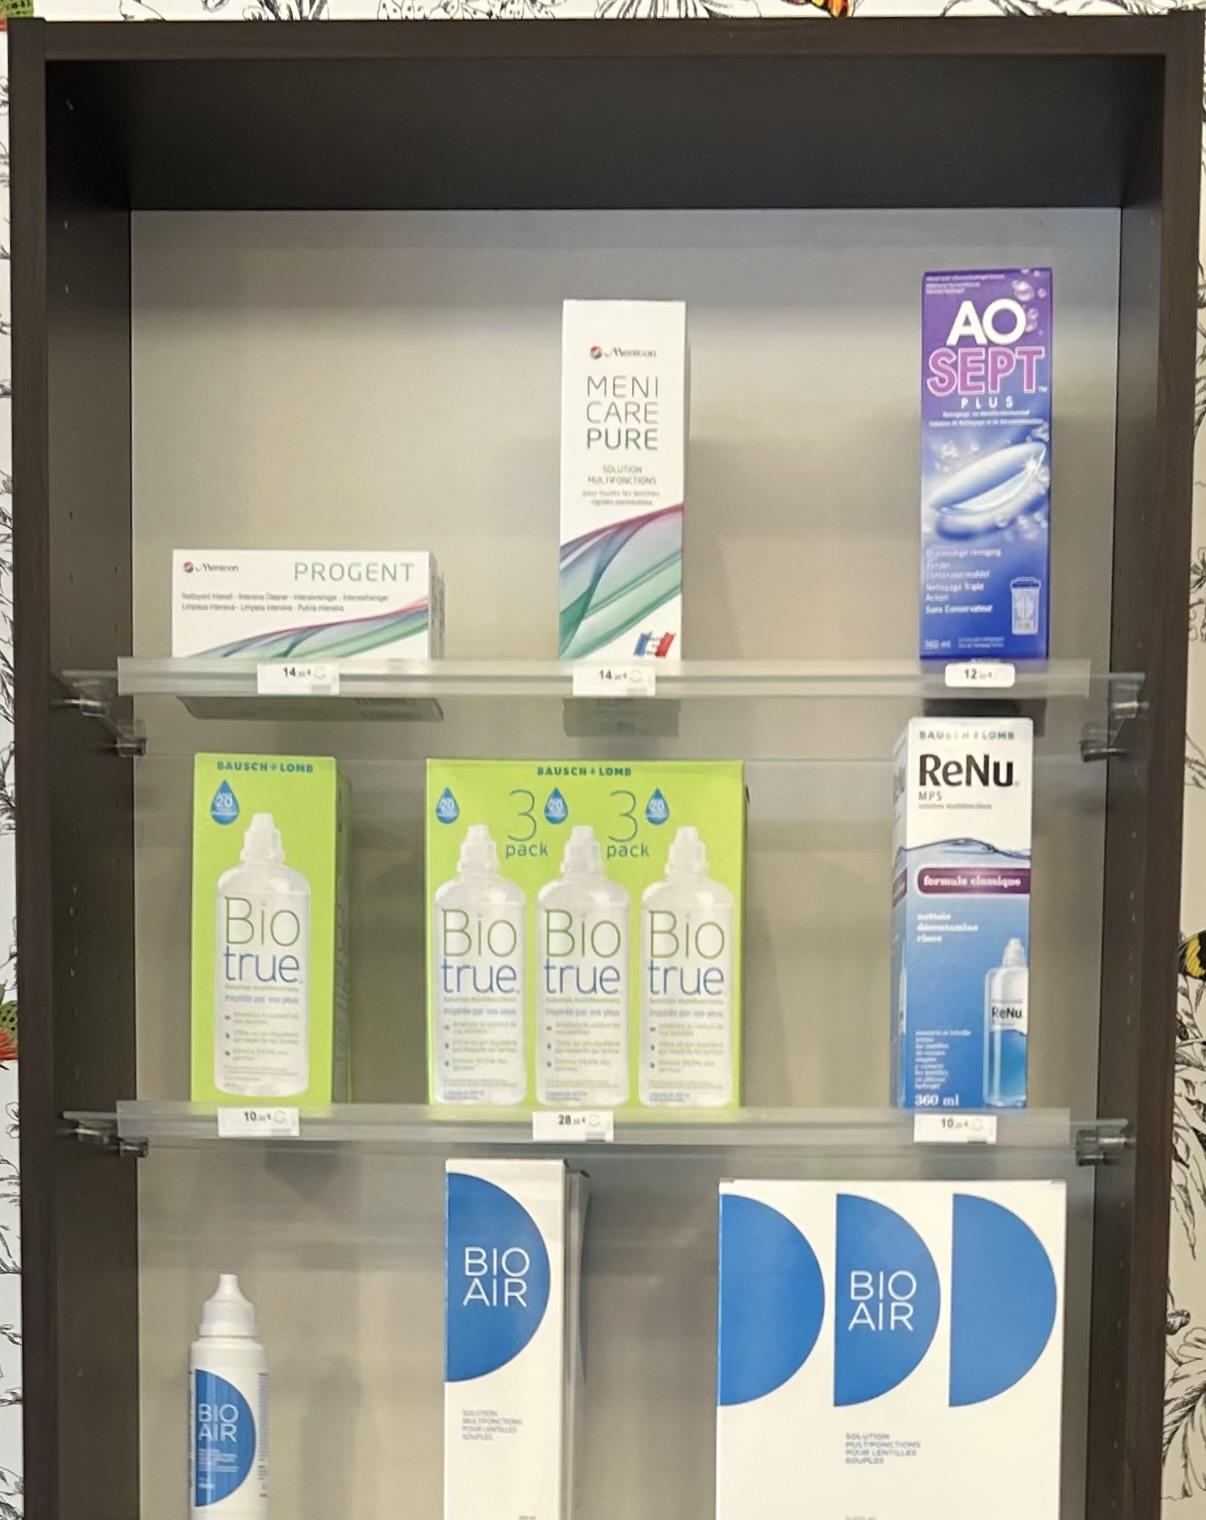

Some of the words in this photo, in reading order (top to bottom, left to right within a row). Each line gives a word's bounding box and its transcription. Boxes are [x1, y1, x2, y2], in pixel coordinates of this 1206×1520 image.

[946, 298, 1026, 345] AO
[604, 347, 656, 358] Menicon
[927, 346, 1045, 397] SEPT
[587, 376, 658, 398] MENI
[586, 401, 658, 424] CARE
[961, 396, 1013, 409] PLUS
[587, 428, 658, 450] PURE
[603, 464, 642, 473] SOLUTION
[587, 476, 656, 485] MULTIFONCTIONS
[294, 562, 415, 582] PROGENT
[982, 732, 1014, 740] LOMB
[217, 761, 268, 771] BAUSCH
[280, 763, 314, 773] LOMB
[537, 767, 587, 776] BAUSCH
[599, 767, 632, 777] LOMB
[919, 754, 1013, 787] ReNu
[507, 789, 538, 842] 3
[608, 790, 638, 842] 3
[505, 841, 548, 859] pack
[606, 841, 649, 859] pack
[924, 875, 967, 887] formule
[970, 875, 1021, 888] classique
[224, 896, 300, 947] Bio
[441, 909, 517, 957] Bio
[544, 908, 621, 958] Bio
[649, 910, 725, 959] Bio
[224, 945, 300, 983] true
[441, 958, 517, 994] true
[544, 958, 620, 995] true
[648, 960, 724, 996] true
[991, 1006, 1022, 1019] ReNu
[914, 1093, 939, 1106] 360
[943, 1093, 959, 1106] ml
[464, 1247, 530, 1277] BIO
[462, 1278, 527, 1307] AIR
[851, 1271, 917, 1301] BIO
[848, 1302, 914, 1331] AIR
[199, 1403, 239, 1423] BIO
[462, 1418, 523, 1426] MULTIFONCTIONS
[198, 1423, 238, 1442] AIR
